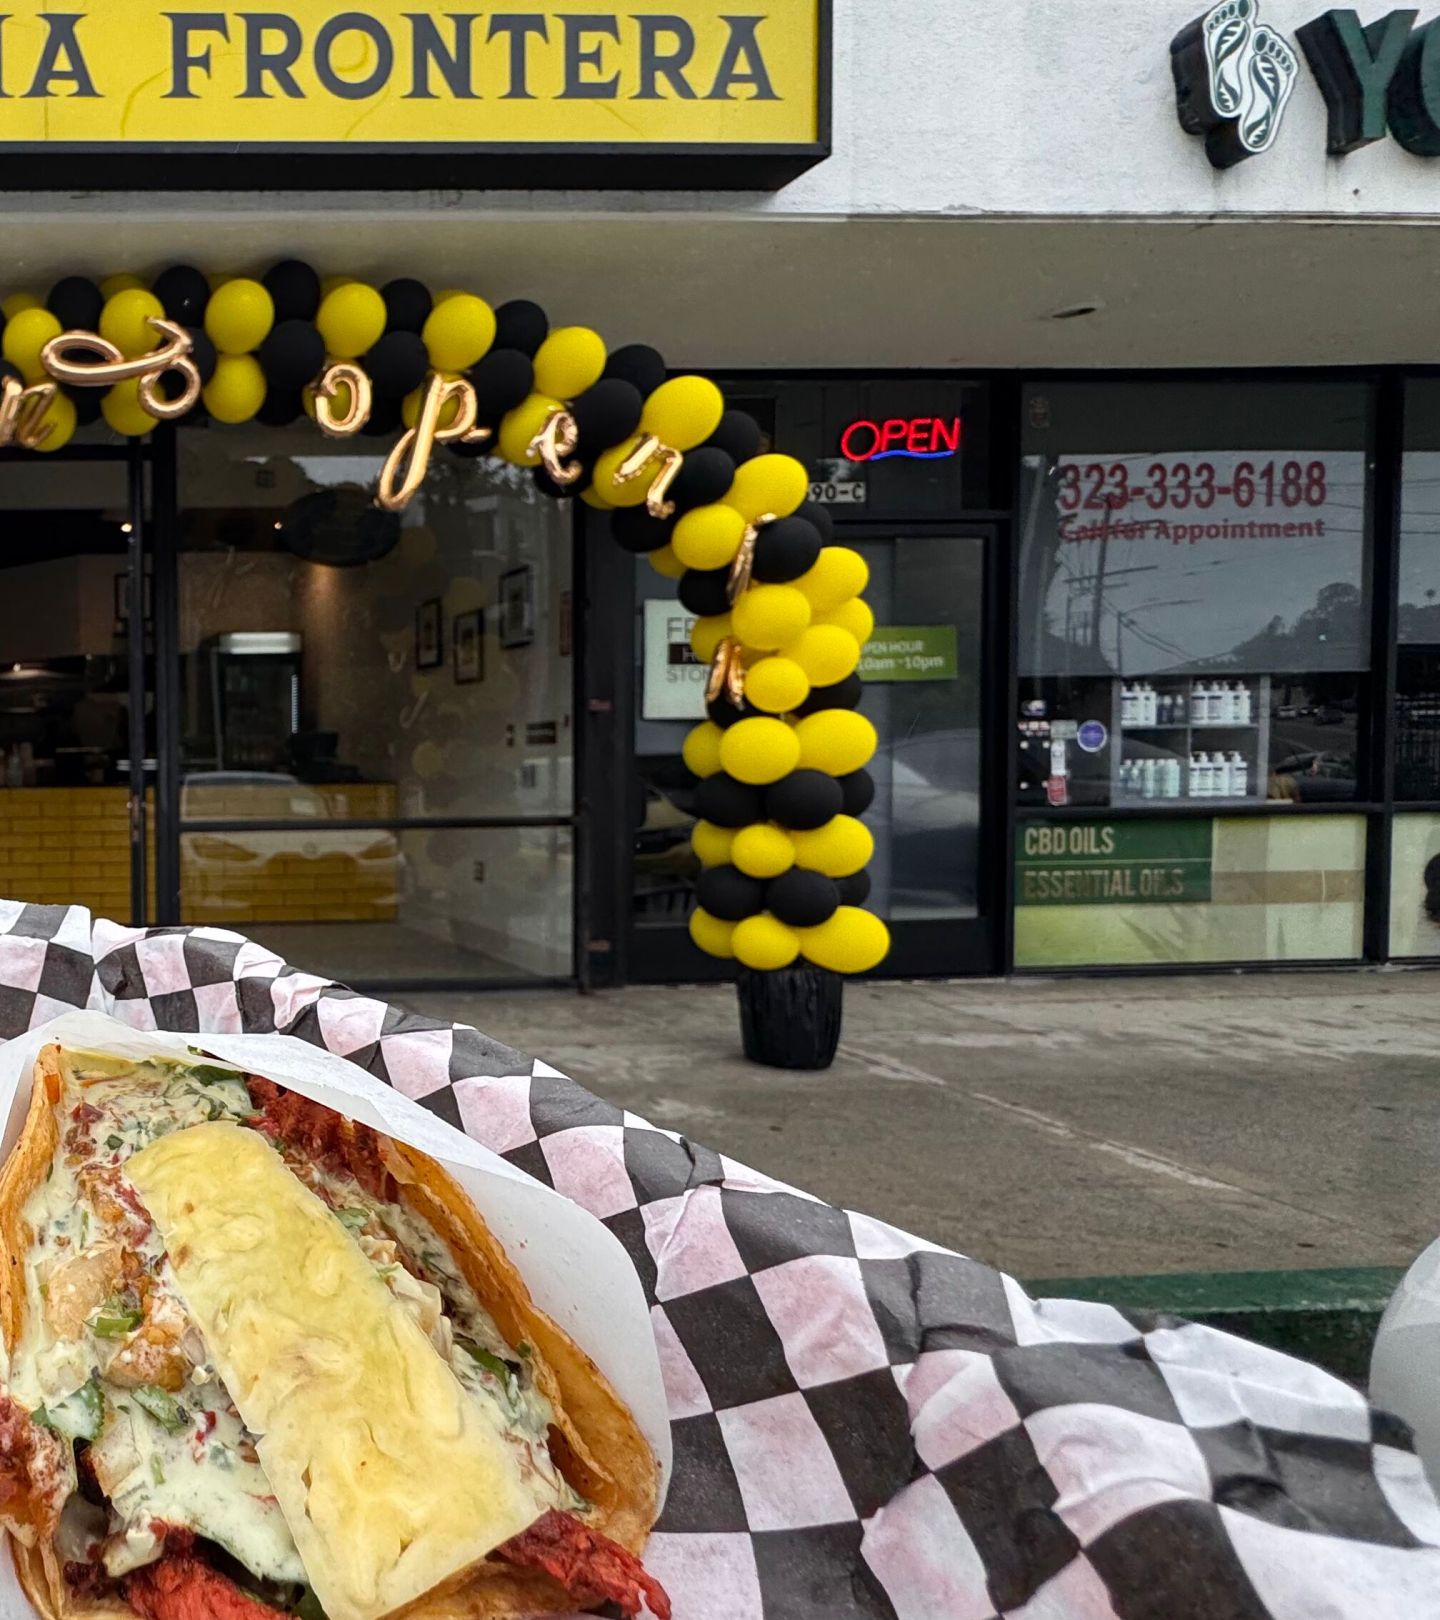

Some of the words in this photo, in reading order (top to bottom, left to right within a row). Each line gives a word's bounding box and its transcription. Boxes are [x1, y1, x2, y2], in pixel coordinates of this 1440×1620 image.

[160, 12, 784, 100] FRONTERA
[1298, 8, 1440, 154] Y
[840, 416, 961, 462] OPEN
[1059, 460, 1327, 511] 323-333-6188
[1154, 517, 1326, 545] Appointment
[862, 642, 888, 653] PEN
[1024, 826, 1065, 856] CBD
[1069, 826, 1116, 854] OILS
[1023, 869, 1136, 898] ESSENTIAL
[1139, 868, 1185, 896] OILS
